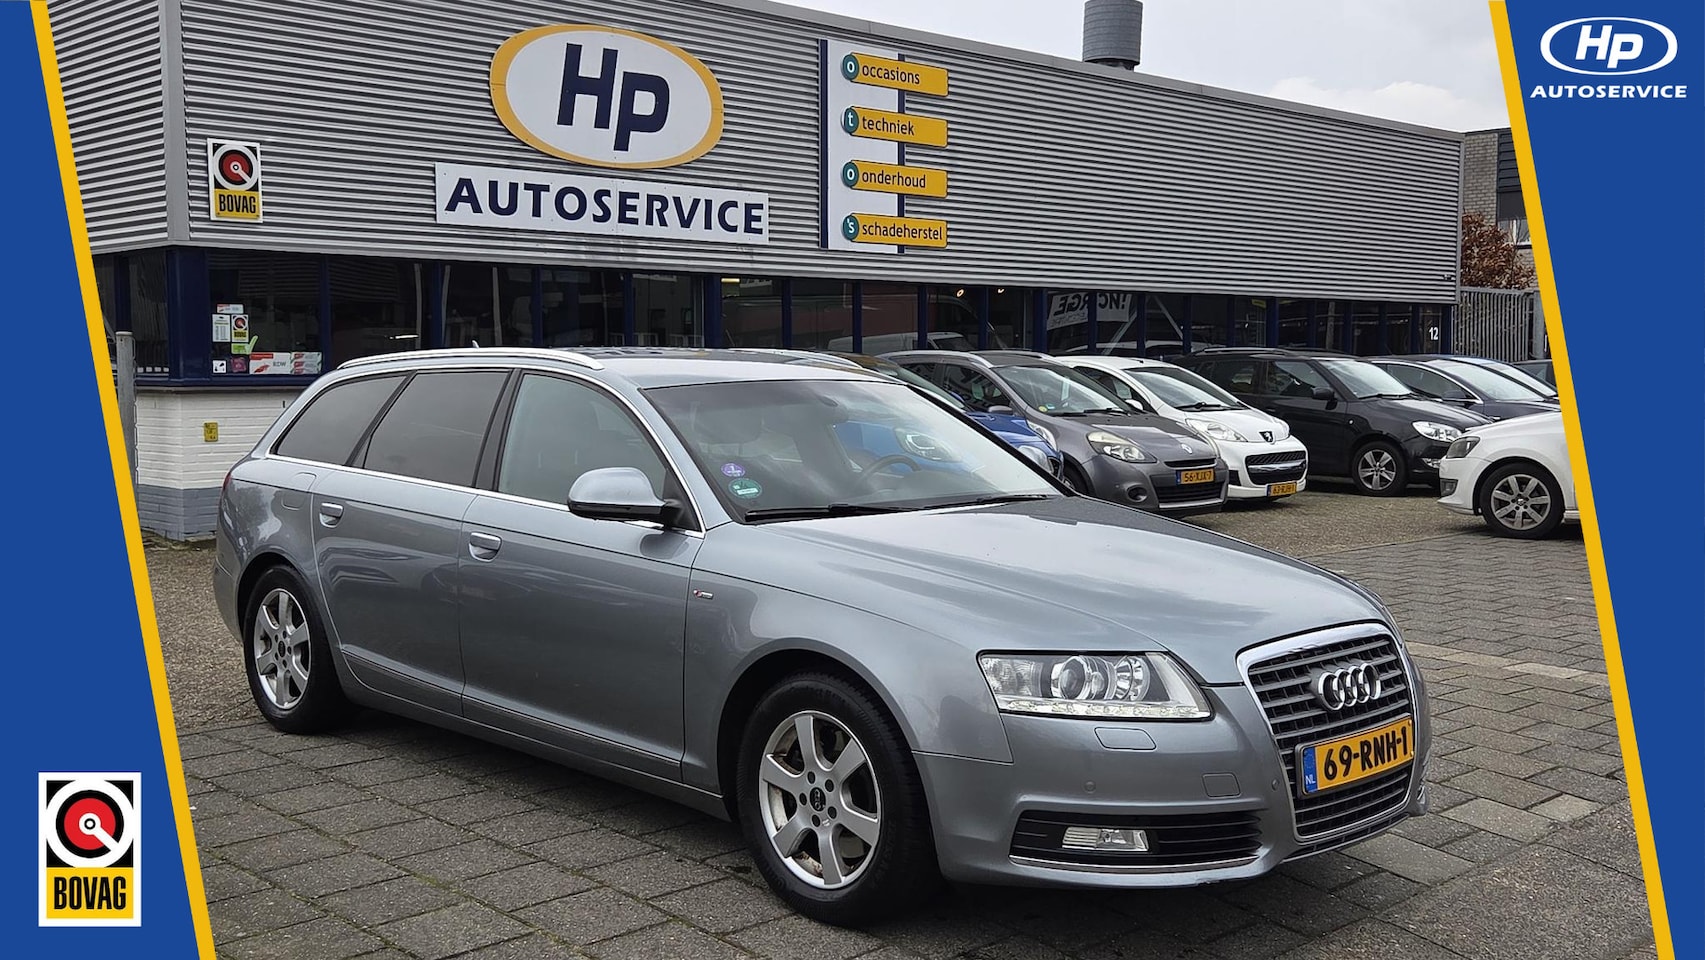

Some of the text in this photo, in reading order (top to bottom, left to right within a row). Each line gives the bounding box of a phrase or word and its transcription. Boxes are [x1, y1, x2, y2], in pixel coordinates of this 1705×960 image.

[862, 65, 920, 84] occasions
[557, 43, 670, 152] Hp
[862, 116, 915, 135] techniek
[862, 170, 926, 188] onderhoud
[219, 193, 256, 213] BOVAG
[445, 177, 764, 235] AUTOSERVICE
[862, 222, 943, 240] schadeherstel
[1428, 327, 1439, 340] 12
[1324, 726, 1407, 780] 69-RNH-1
[1305, 774, 1316, 785] NL
